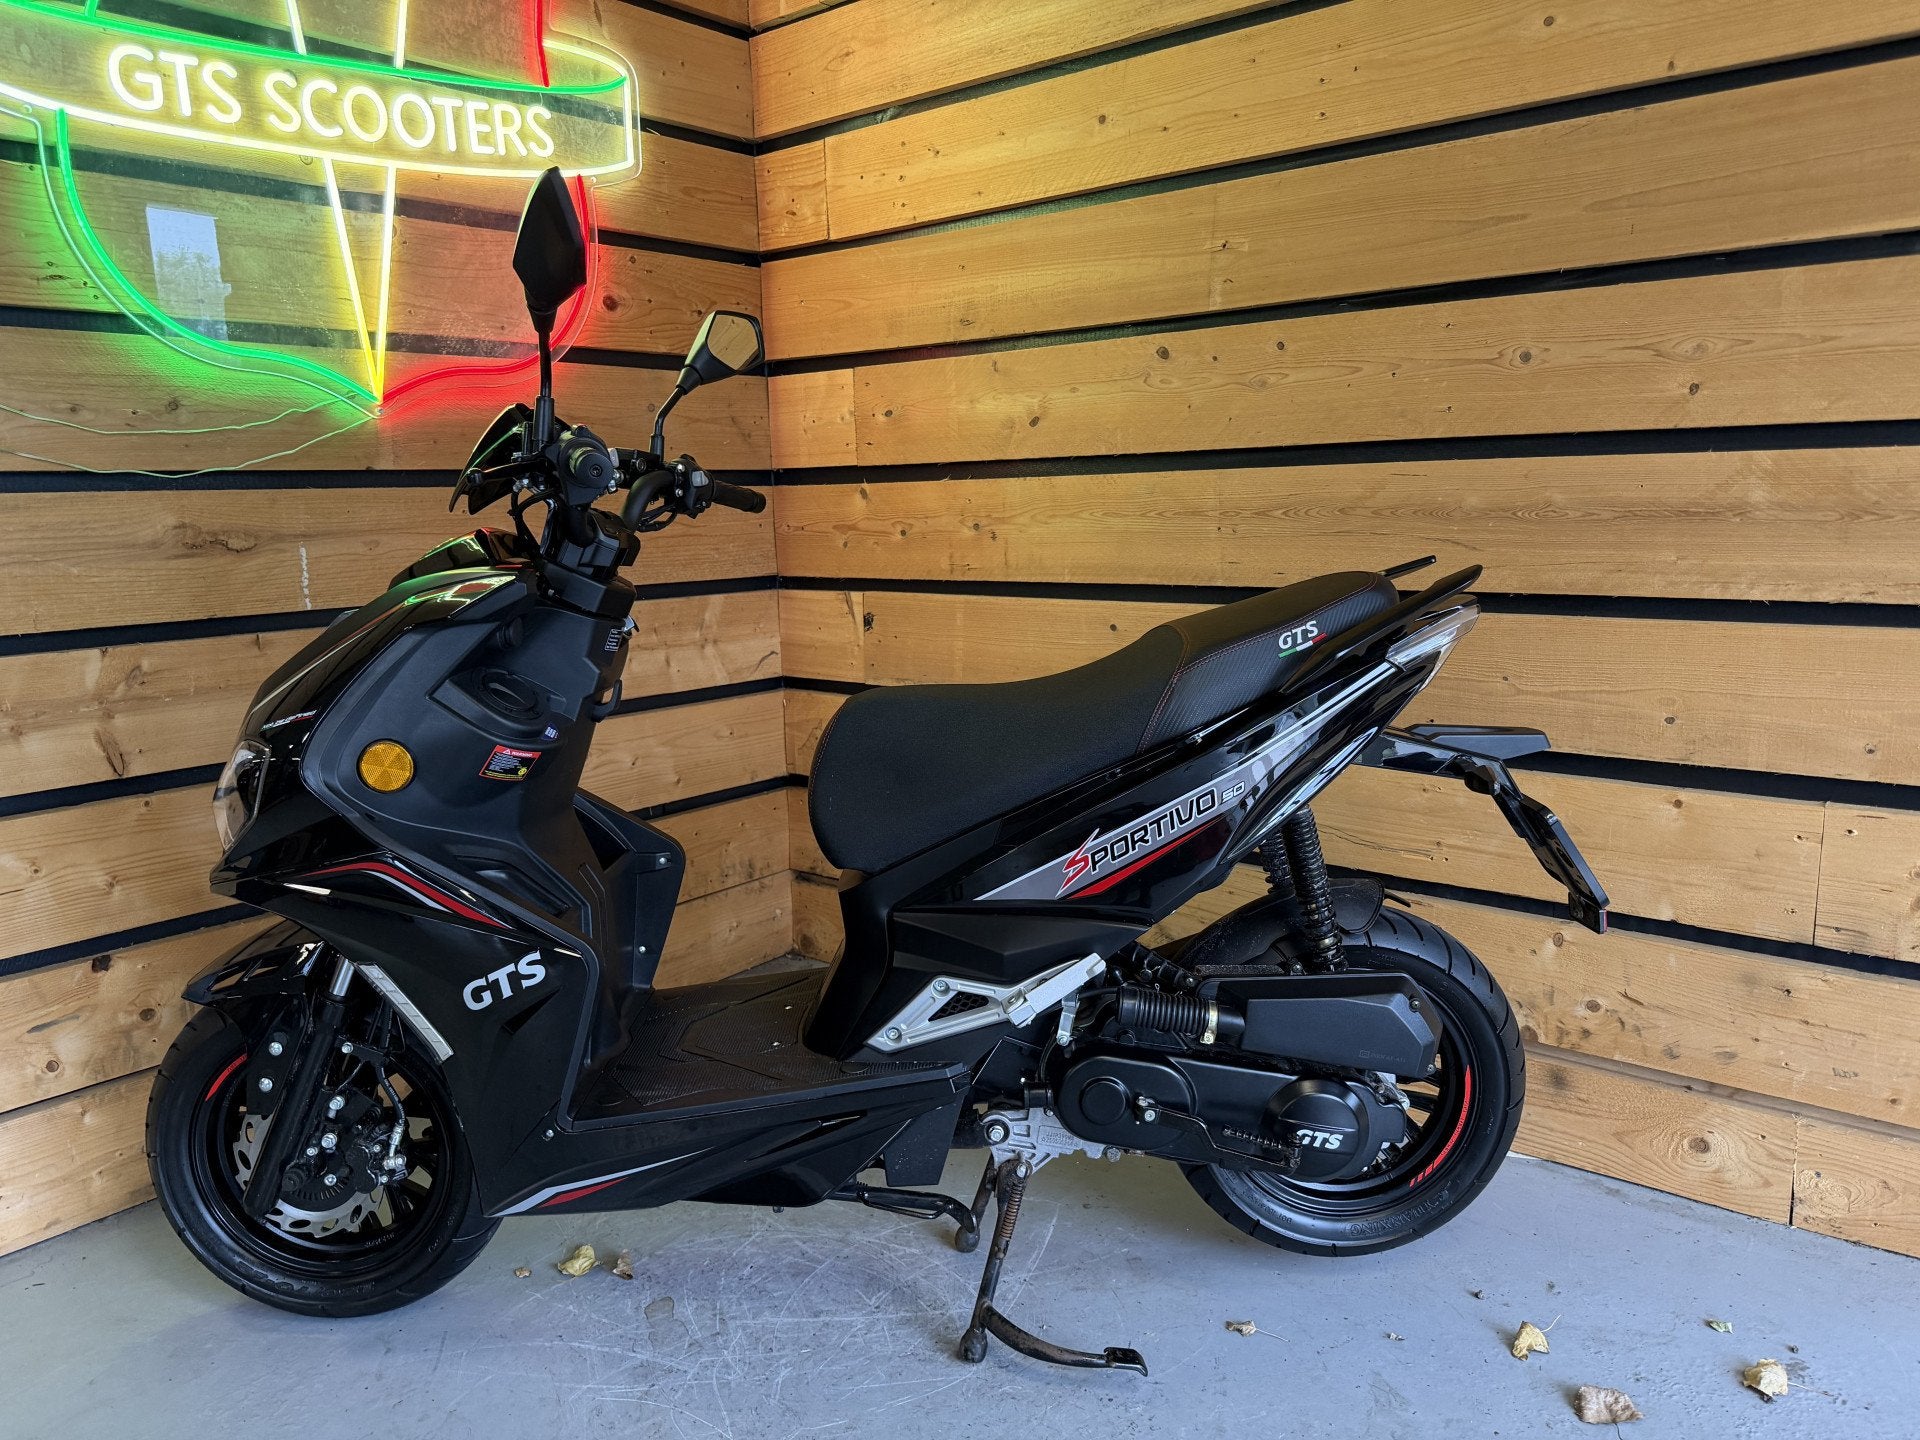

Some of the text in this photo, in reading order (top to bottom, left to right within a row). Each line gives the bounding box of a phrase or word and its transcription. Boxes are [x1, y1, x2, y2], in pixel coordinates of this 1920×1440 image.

[107, 44, 556, 159] GTS SCOOTERS
[1278, 620, 1319, 650] GTS
[1055, 781, 1245, 898] SPORTIVO 50
[463, 949, 546, 1011] GTS
[1296, 1129, 1344, 1150] GTS
